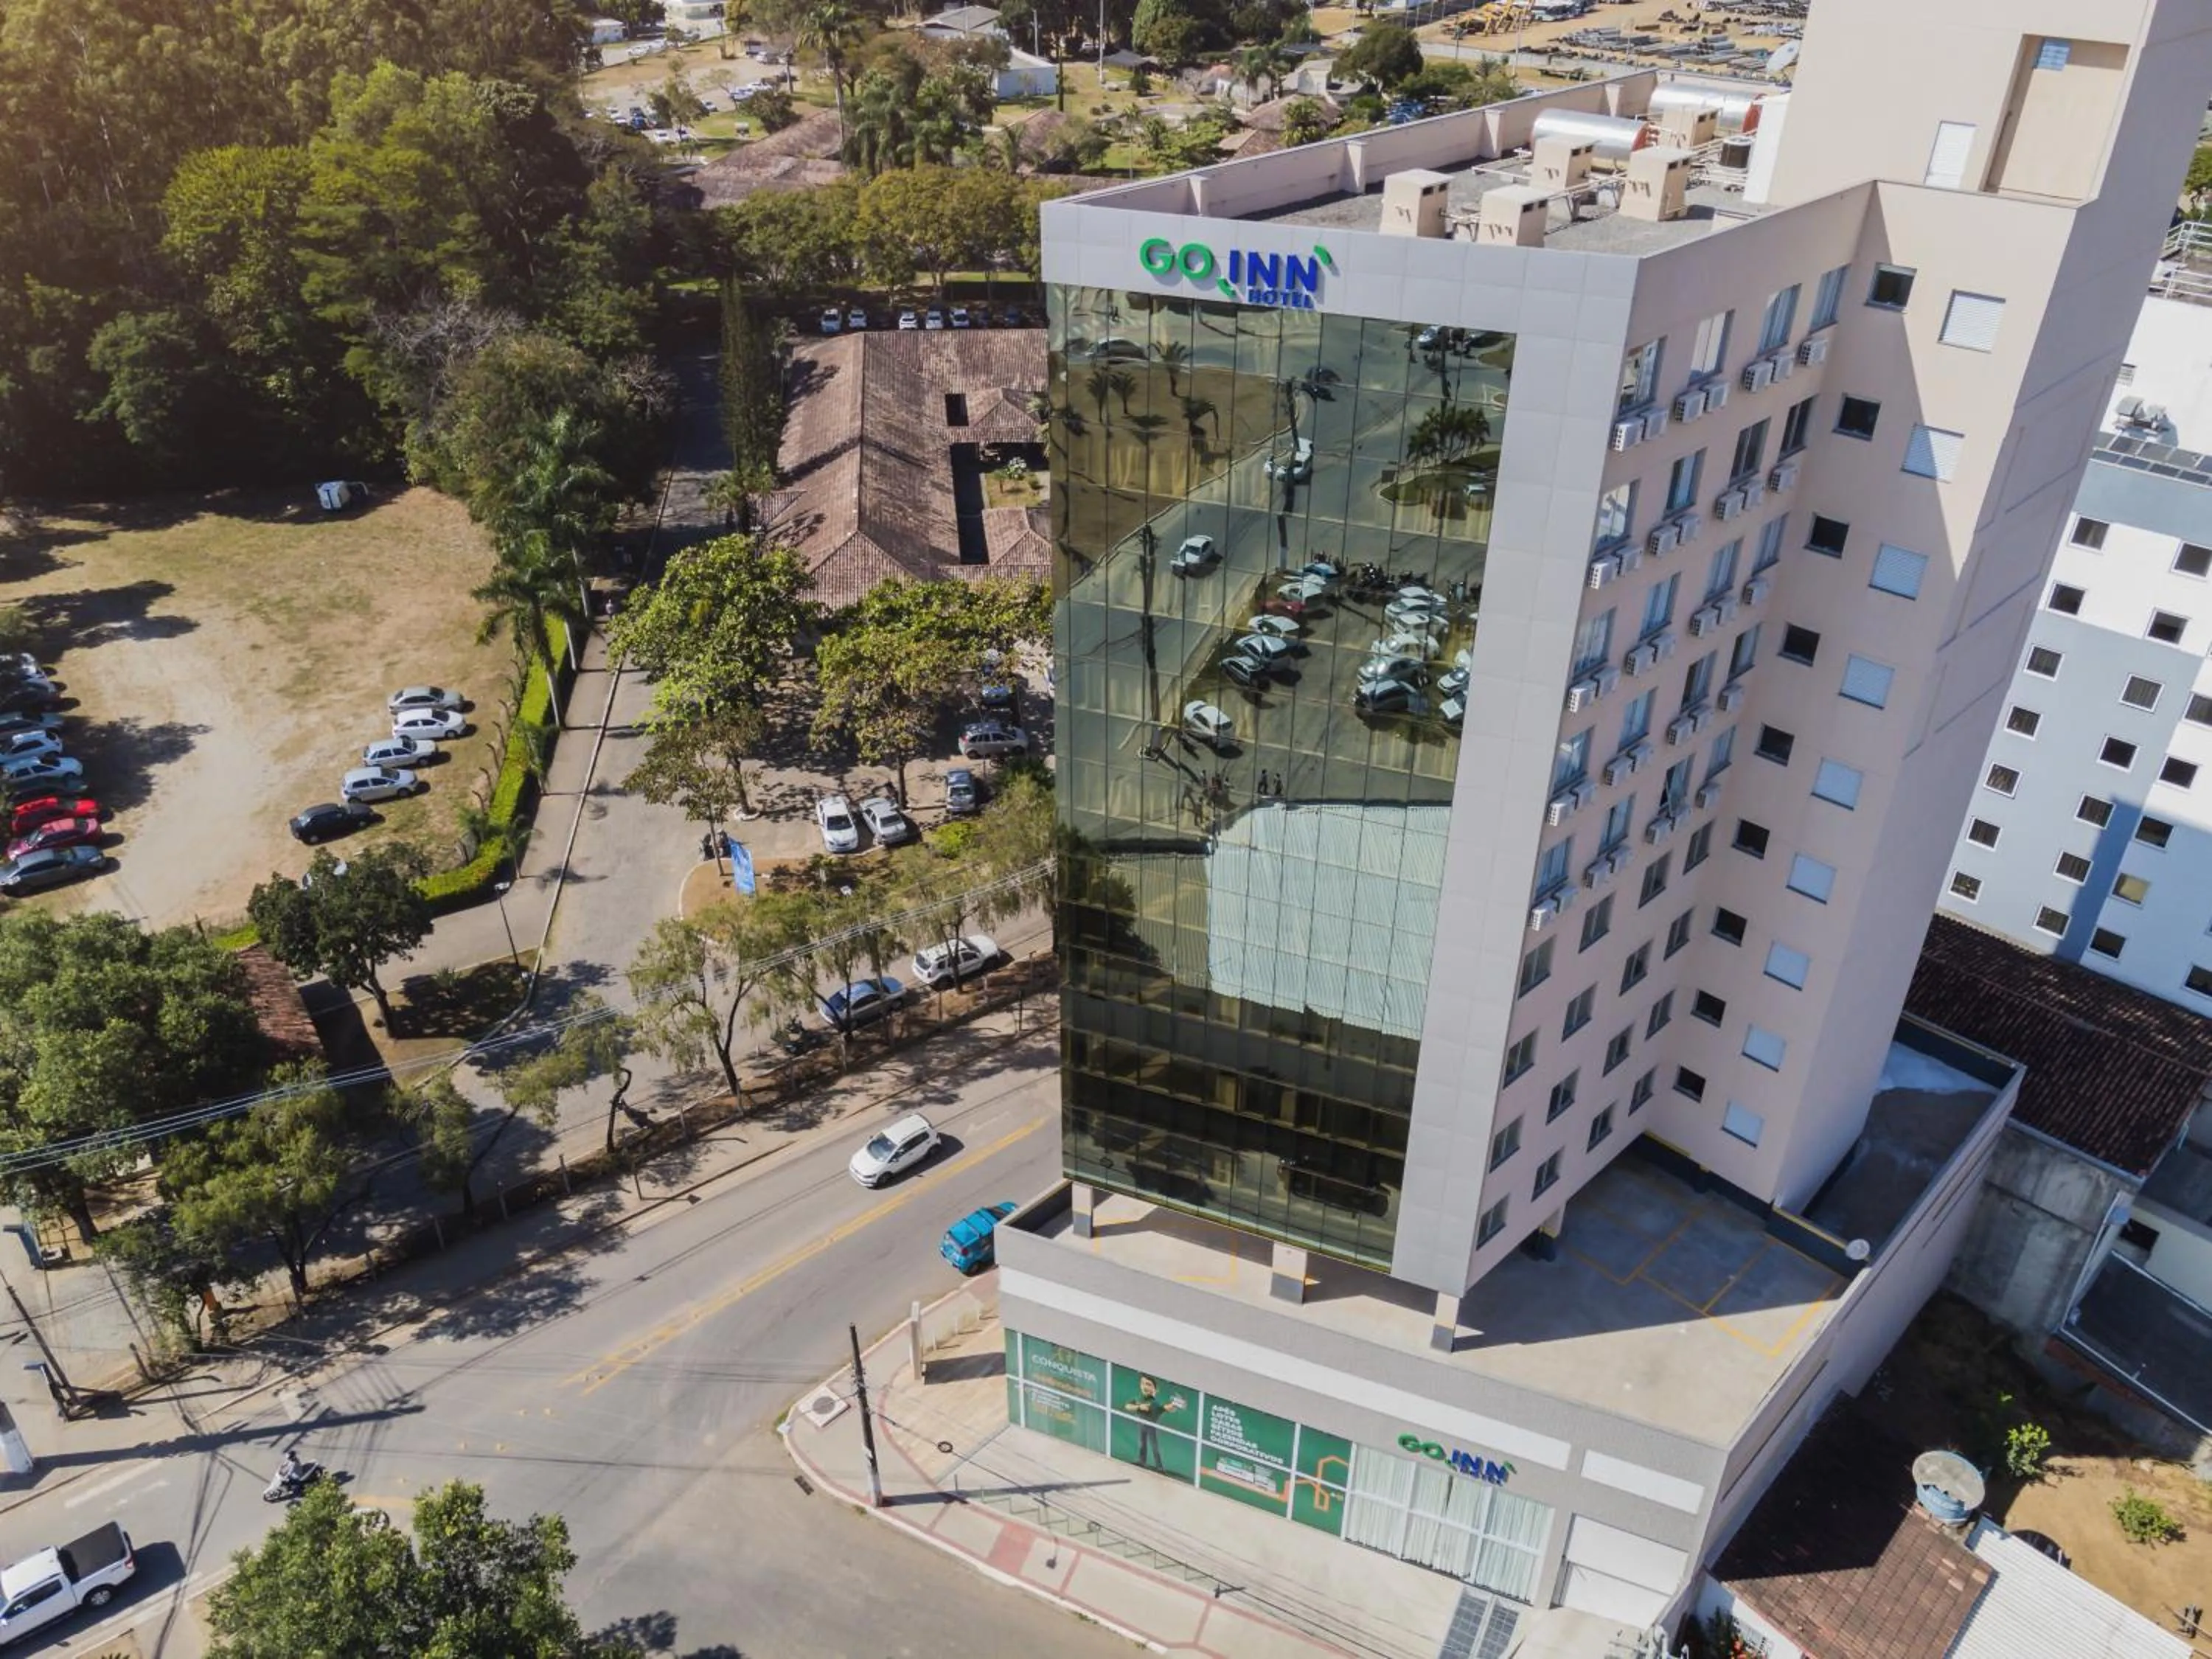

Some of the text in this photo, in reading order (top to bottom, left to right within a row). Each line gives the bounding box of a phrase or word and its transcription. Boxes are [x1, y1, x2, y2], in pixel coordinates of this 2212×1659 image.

[1229, 250, 1317, 293] INN
[1248, 288, 1313, 308] HOTEL
[1032, 1354, 1097, 1382] CONQUISTA
[1452, 1449, 1509, 1484] INN
